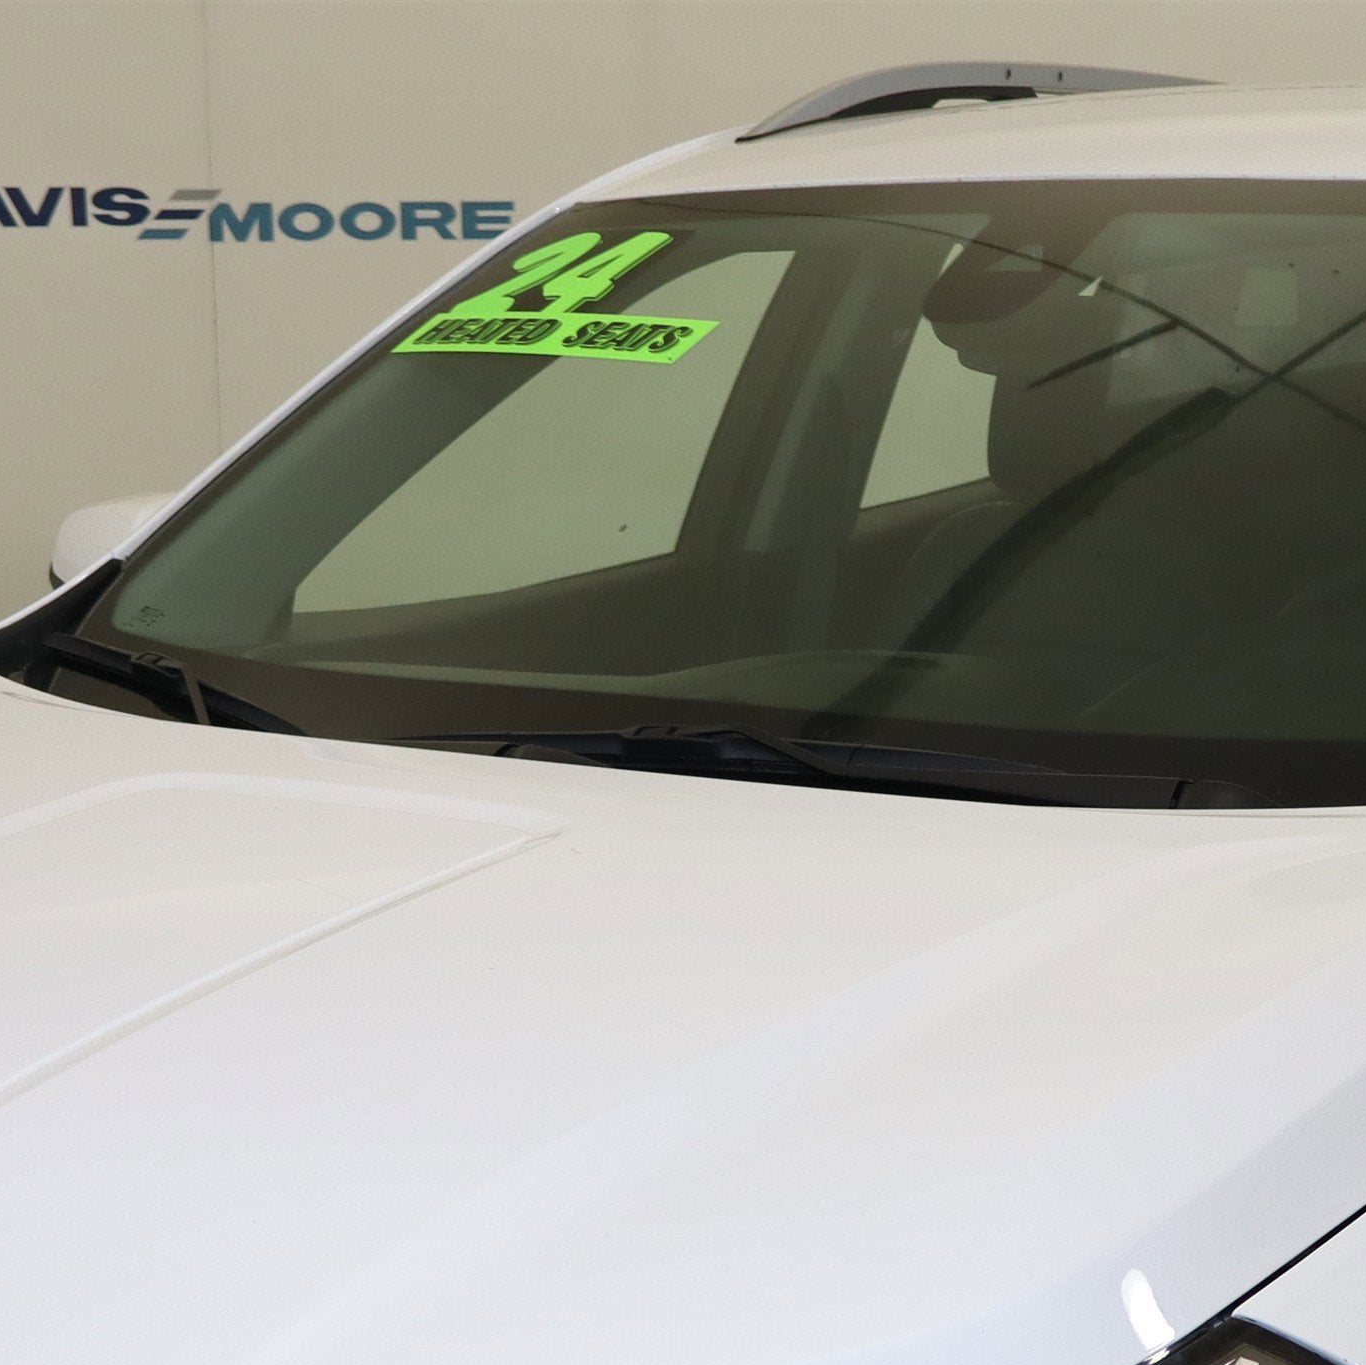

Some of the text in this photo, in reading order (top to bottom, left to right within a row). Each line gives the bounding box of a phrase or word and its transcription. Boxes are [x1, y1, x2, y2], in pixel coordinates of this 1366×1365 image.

[208, 199, 514, 243] MOORE
[449, 231, 674, 314] 24
[412, 318, 694, 353] HEATED SEATS
